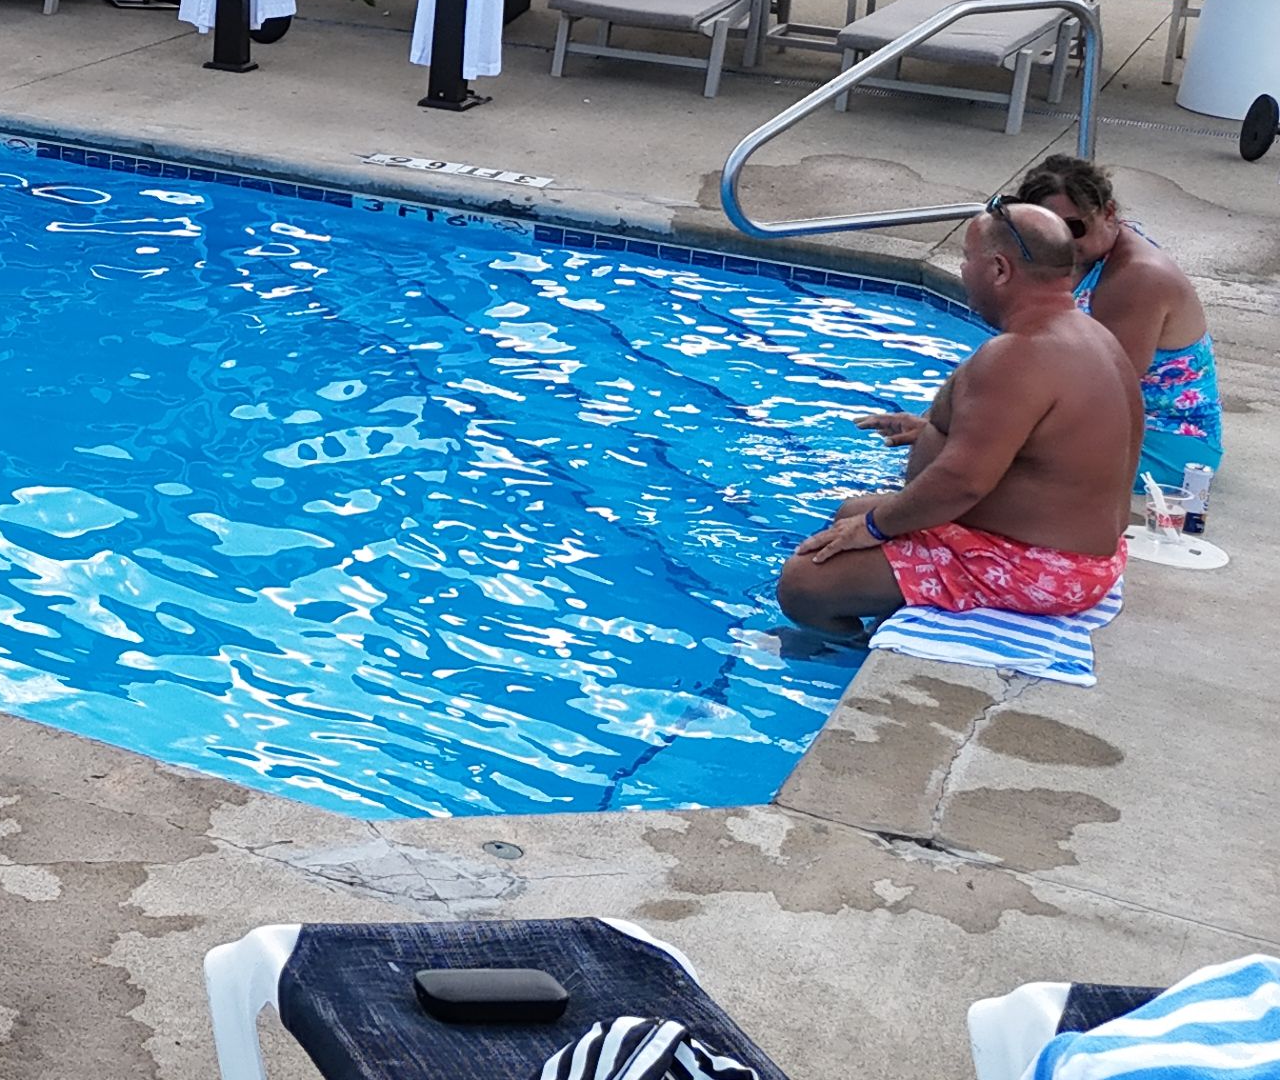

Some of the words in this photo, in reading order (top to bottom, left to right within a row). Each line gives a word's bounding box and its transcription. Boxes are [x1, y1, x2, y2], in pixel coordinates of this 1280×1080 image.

[424, 161, 447, 170] 6
[457, 166, 503, 179] FT
[513, 174, 537, 184] 3
[362, 198, 384, 212] 3
[398, 204, 440, 222] FT
[445, 214, 468, 227] 6
